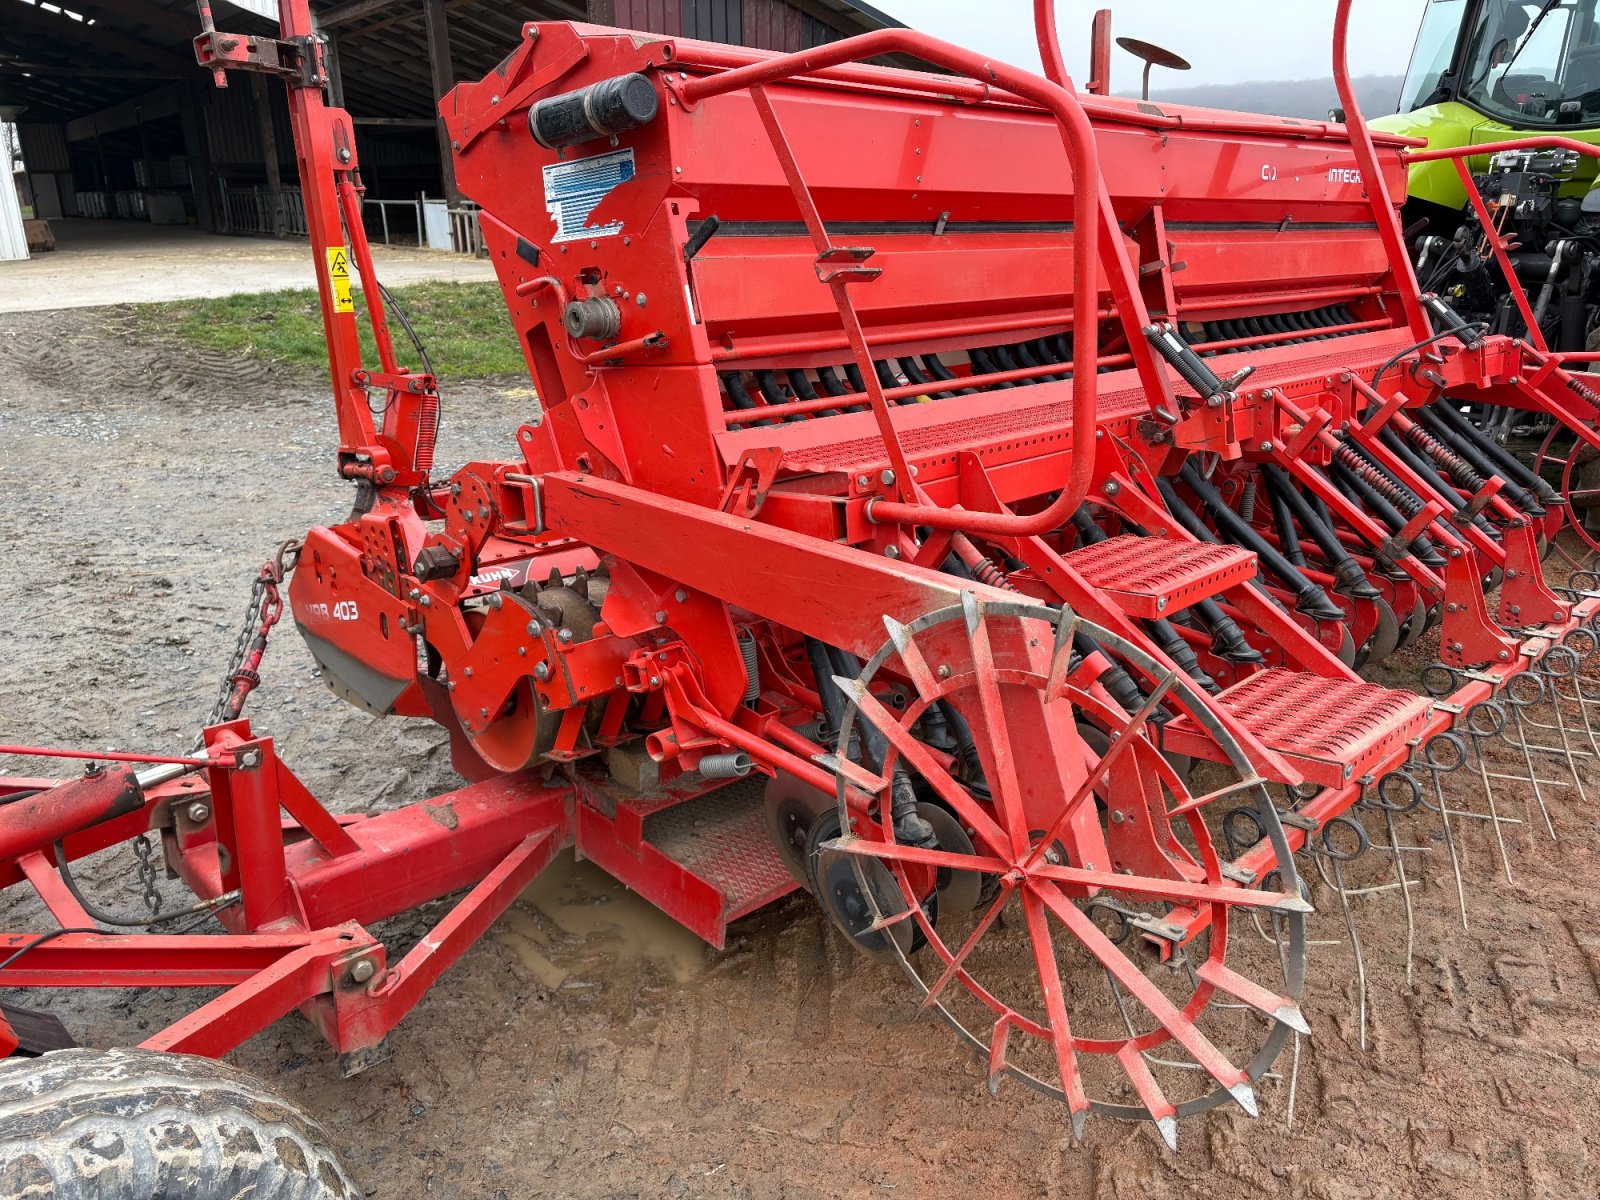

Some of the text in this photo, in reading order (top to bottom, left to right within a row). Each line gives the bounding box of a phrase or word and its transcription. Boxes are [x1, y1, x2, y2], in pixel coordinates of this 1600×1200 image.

[1328, 168, 1363, 184] INTEGR
[469, 568, 513, 585] KUHN
[333, 600, 359, 621] 403
